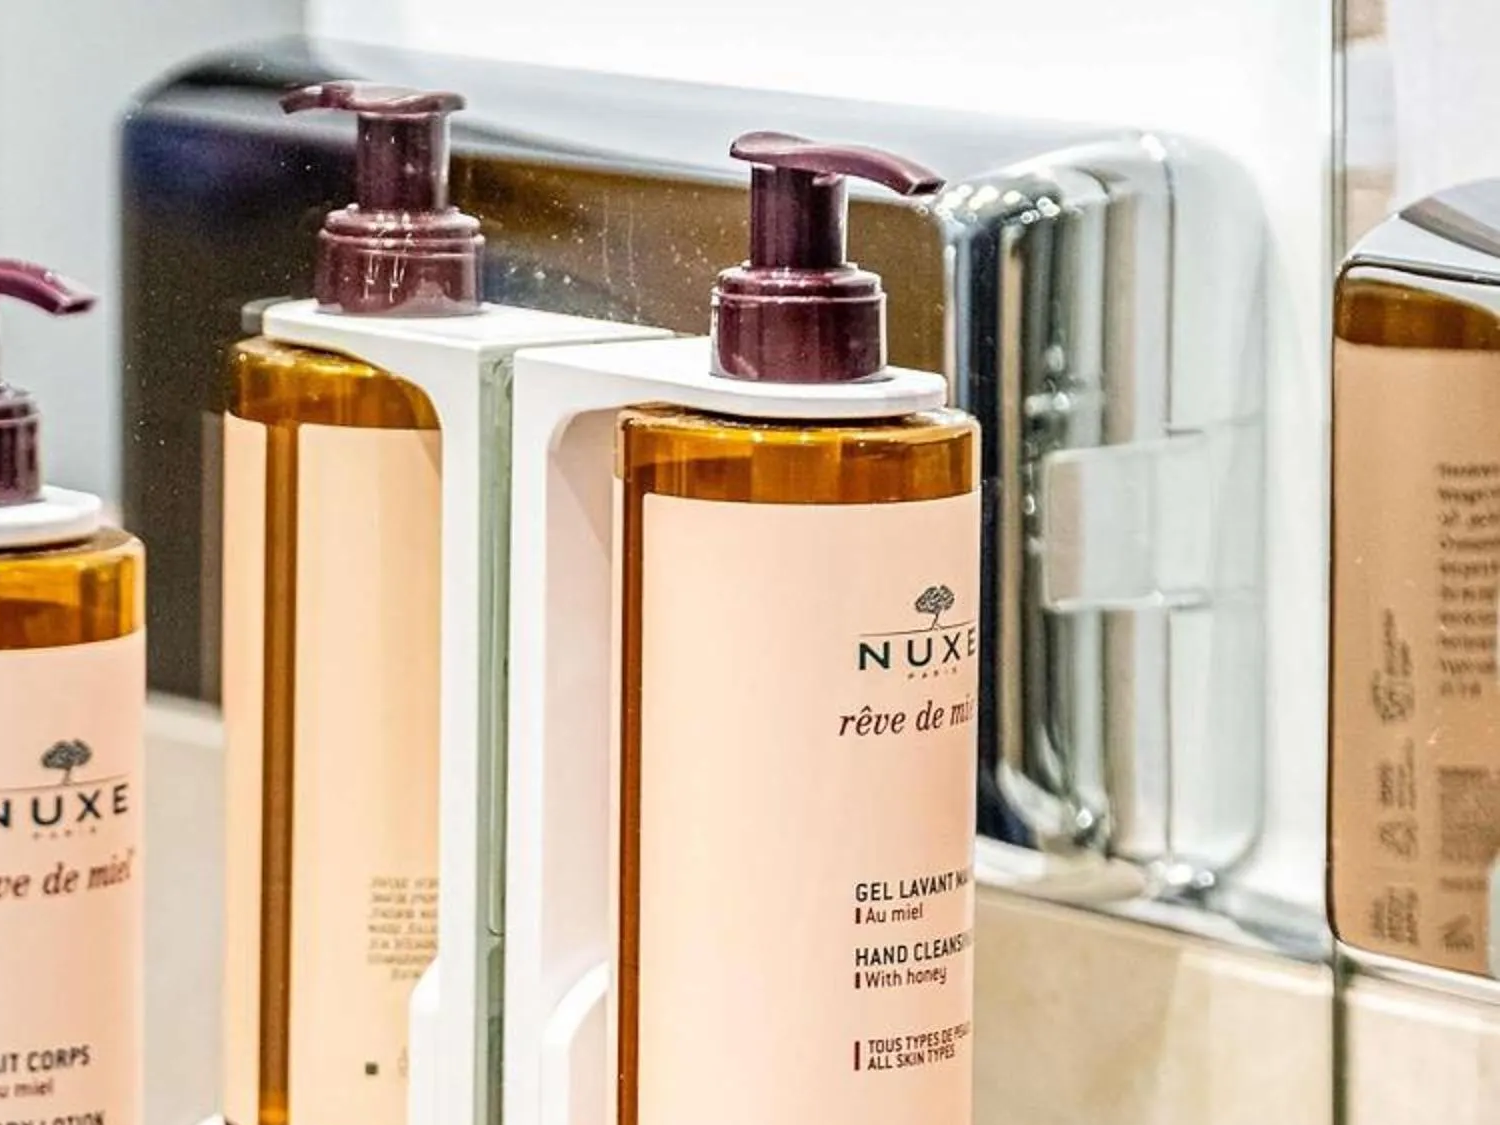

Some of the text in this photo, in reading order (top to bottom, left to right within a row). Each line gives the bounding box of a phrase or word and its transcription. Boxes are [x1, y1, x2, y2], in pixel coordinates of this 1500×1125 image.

[858, 627, 976, 671] NUXE
[839, 705, 906, 736] rêve
[916, 700, 945, 731] de
[43, 862, 79, 896] de
[855, 882, 893, 902] GEL
[900, 872, 953, 899] LAVANT
[866, 902, 923, 923] Au miel
[855, 931, 972, 967] HAND CLEANS
[865, 966, 947, 988] With honey
[868, 1037, 902, 1054] TOUS
[906, 1031, 939, 1051] TYPES
[941, 1027, 953, 1044] DE
[27, 1046, 90, 1072] CORPS
[867, 1044, 955, 1070] ALL SKIN TYPES
[14, 1078, 53, 1097] miel
